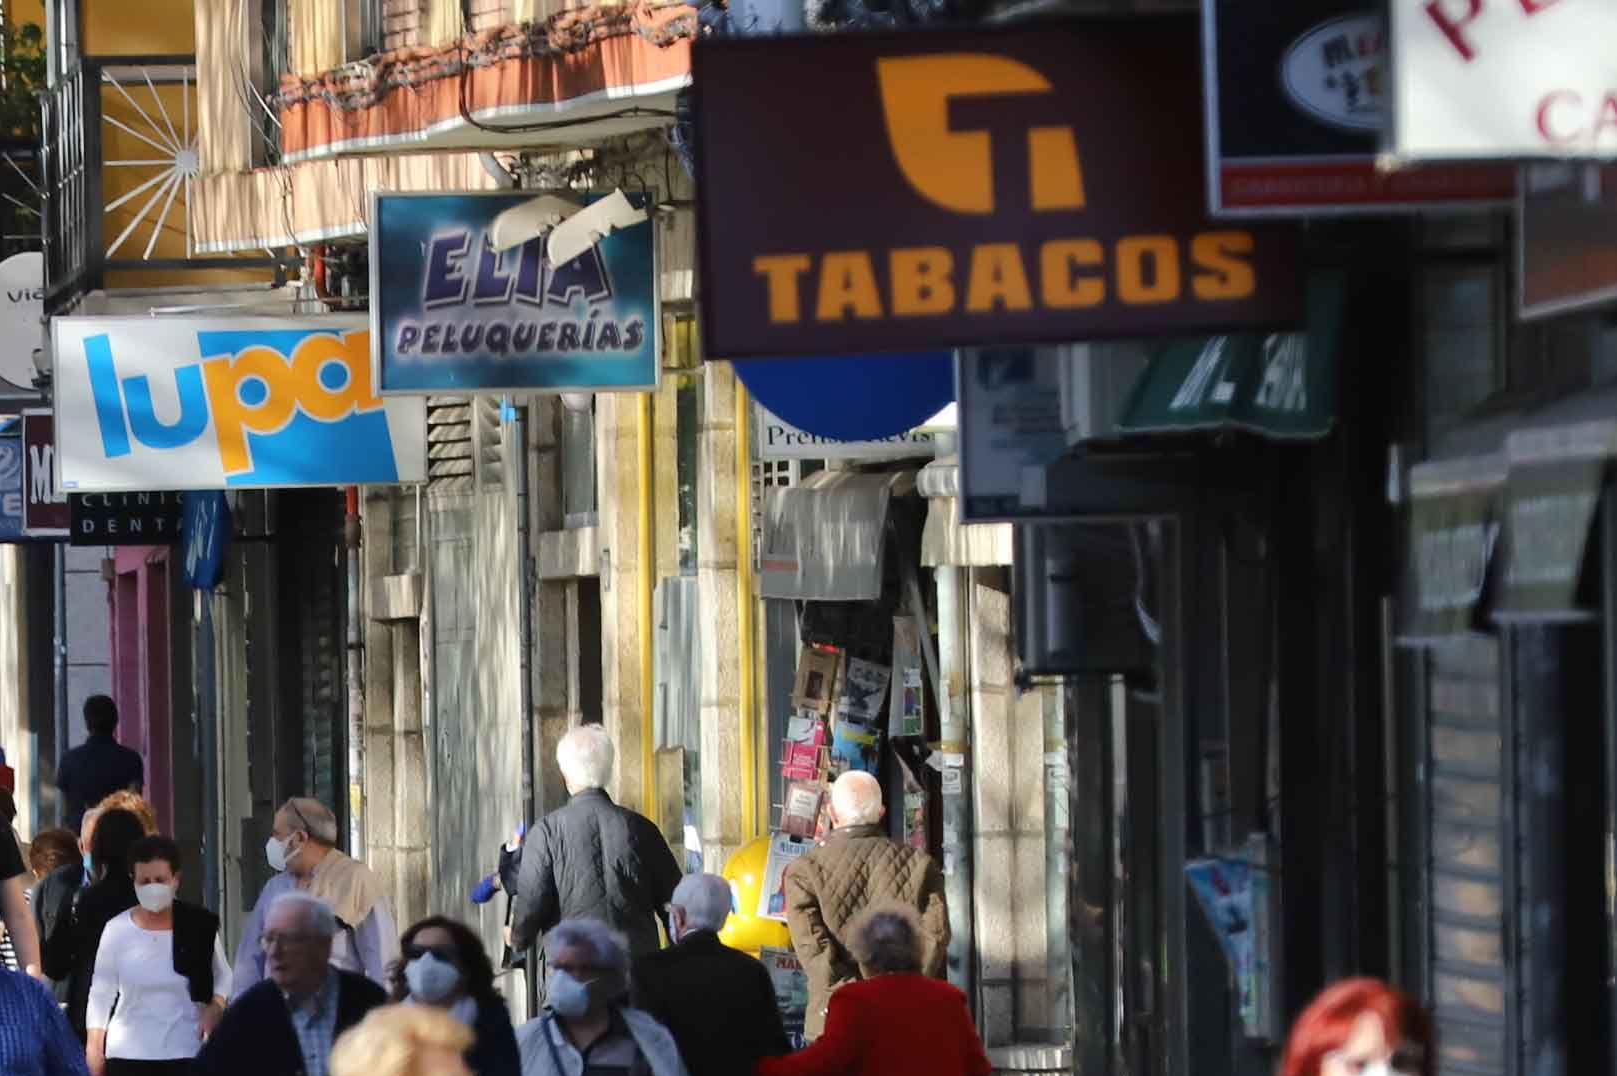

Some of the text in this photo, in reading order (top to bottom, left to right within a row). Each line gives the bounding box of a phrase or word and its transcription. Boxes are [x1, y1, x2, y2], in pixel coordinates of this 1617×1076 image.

[423, 228, 613, 309] ELIA
[752, 231, 1256, 325] TABACOS
[397, 310, 644, 355] PELUQUERÍAS
[83, 330, 383, 473] lupa
